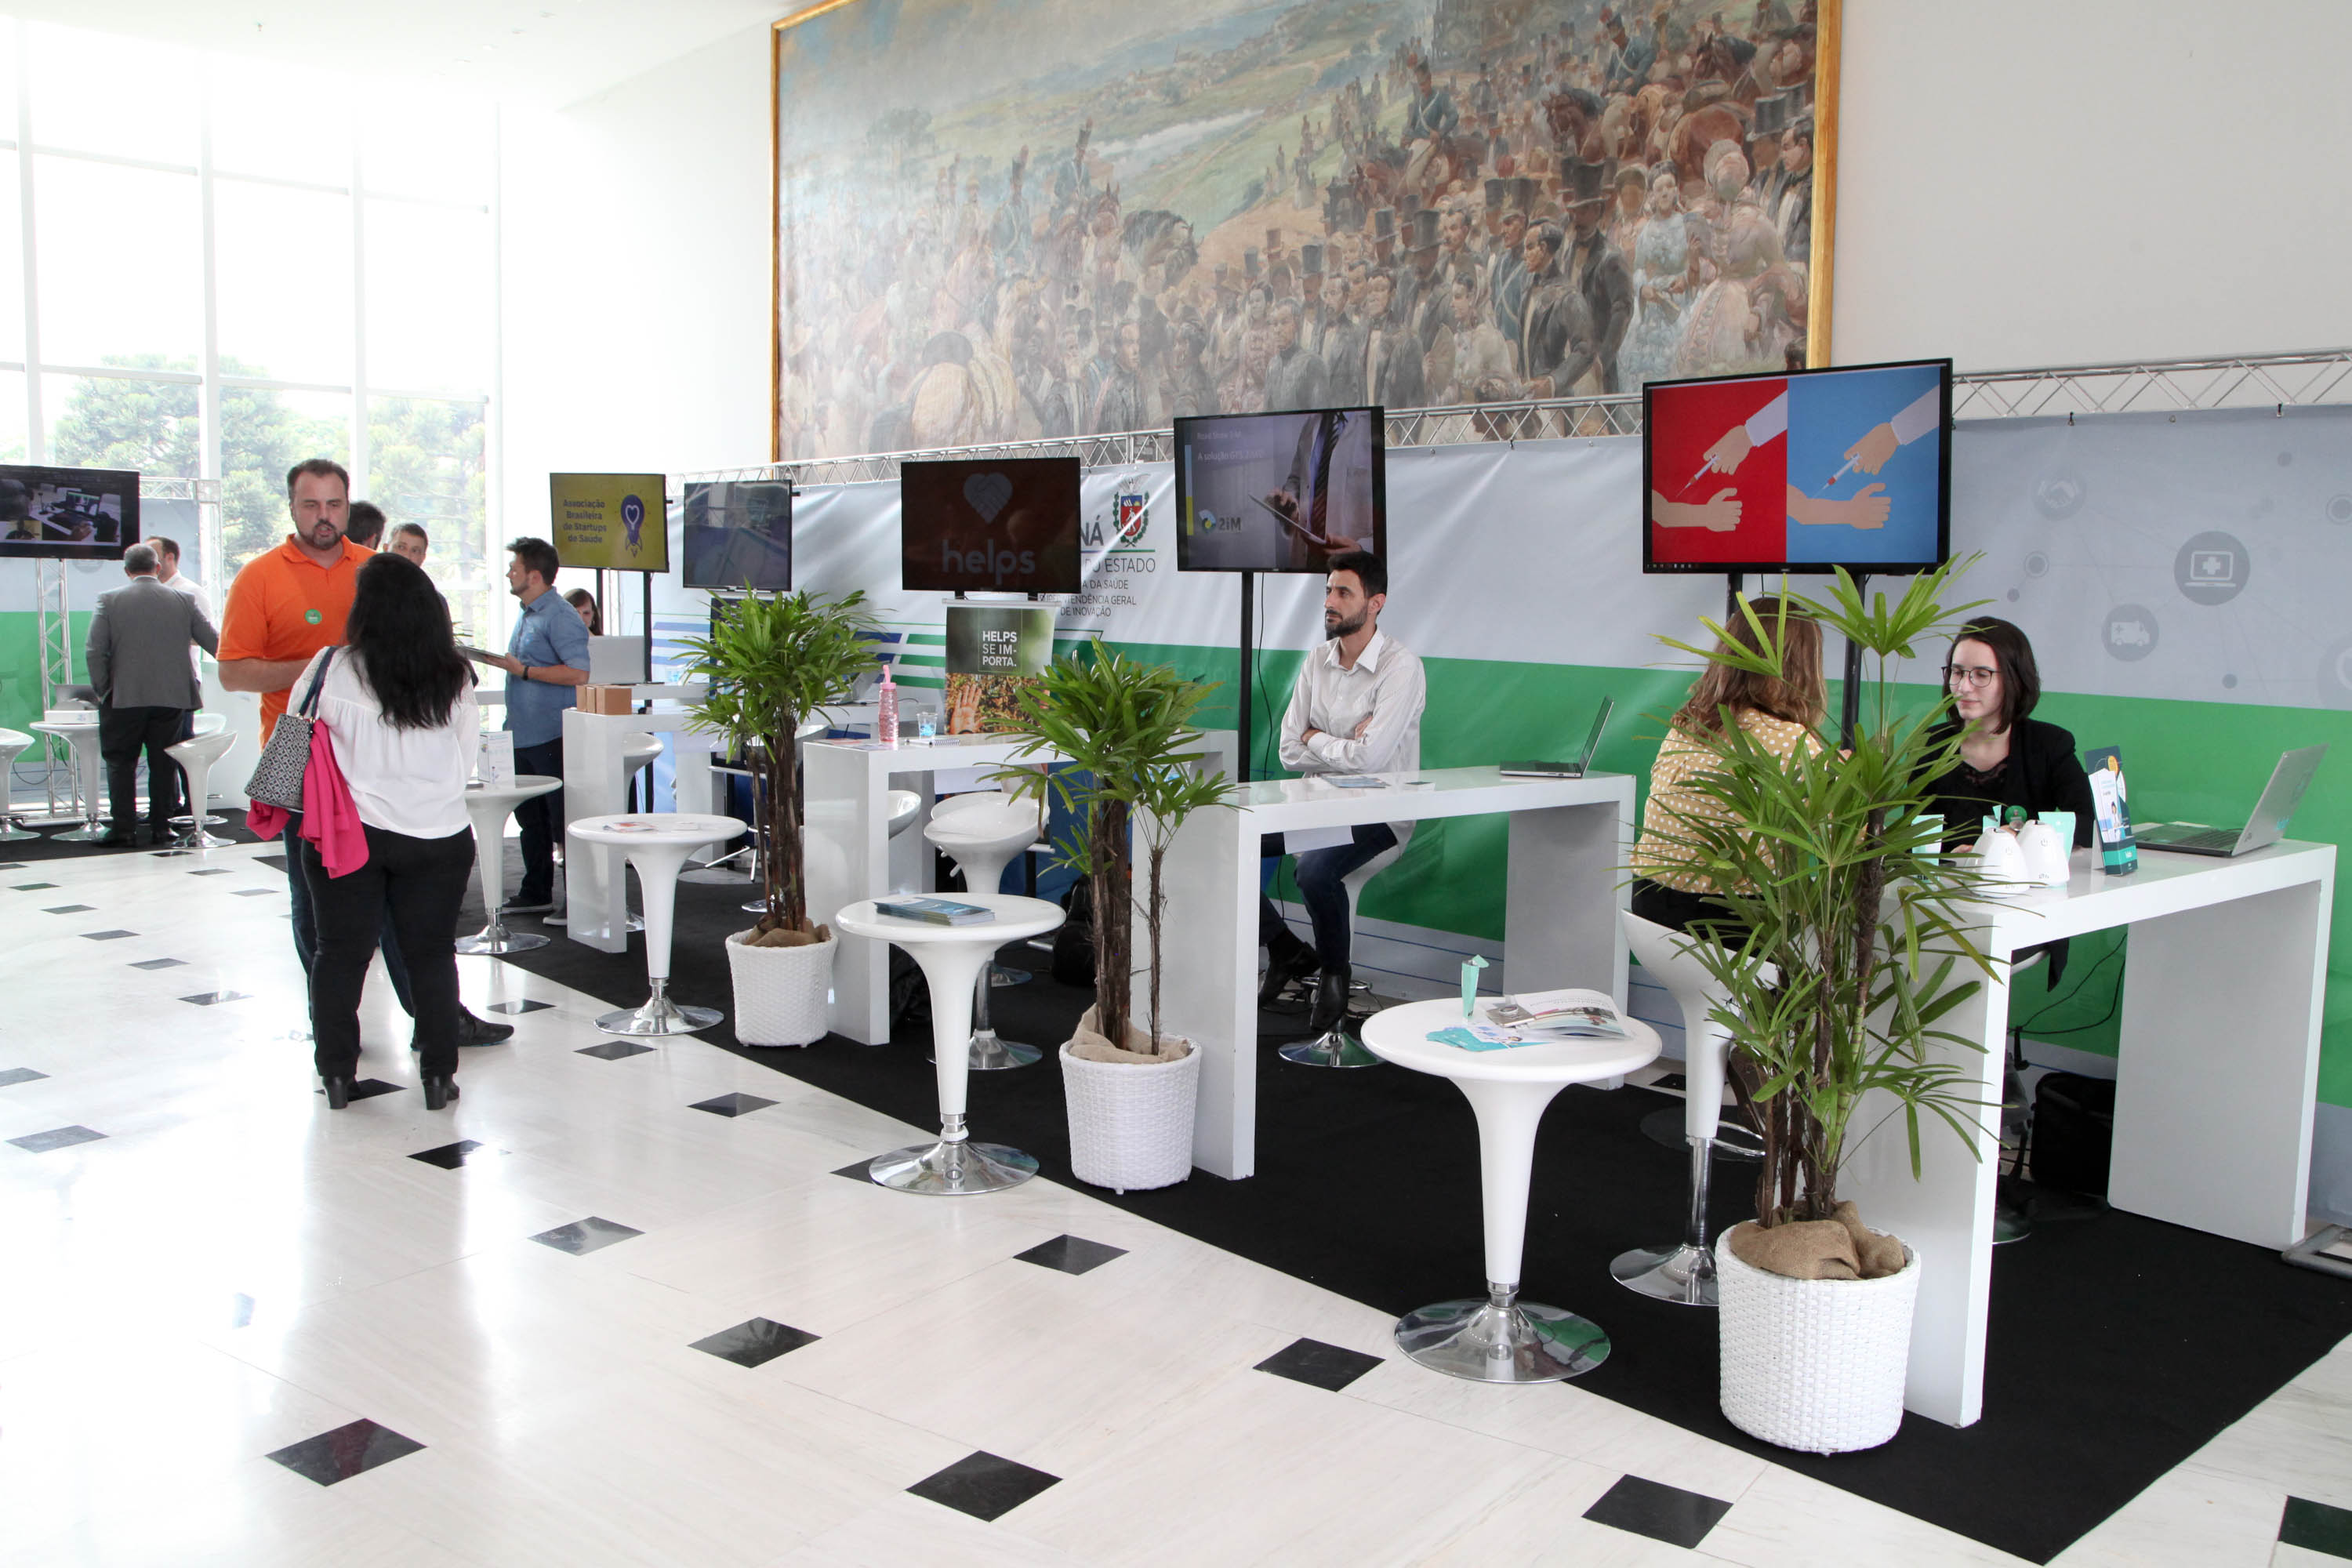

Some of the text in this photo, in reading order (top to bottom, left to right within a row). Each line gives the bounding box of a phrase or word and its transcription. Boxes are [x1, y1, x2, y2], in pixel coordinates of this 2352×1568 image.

[942, 539, 1035, 585] helps
[1105, 557, 1156, 573] ESTADO
[1090, 579, 1102, 590] DA
[1111, 595, 1136, 605] GERAL
[1060, 607, 1071, 616] DE
[982, 630, 1018, 642] HELPS
[982, 643, 1017, 655] SE IM-
[982, 655, 1017, 667] PORTA.
